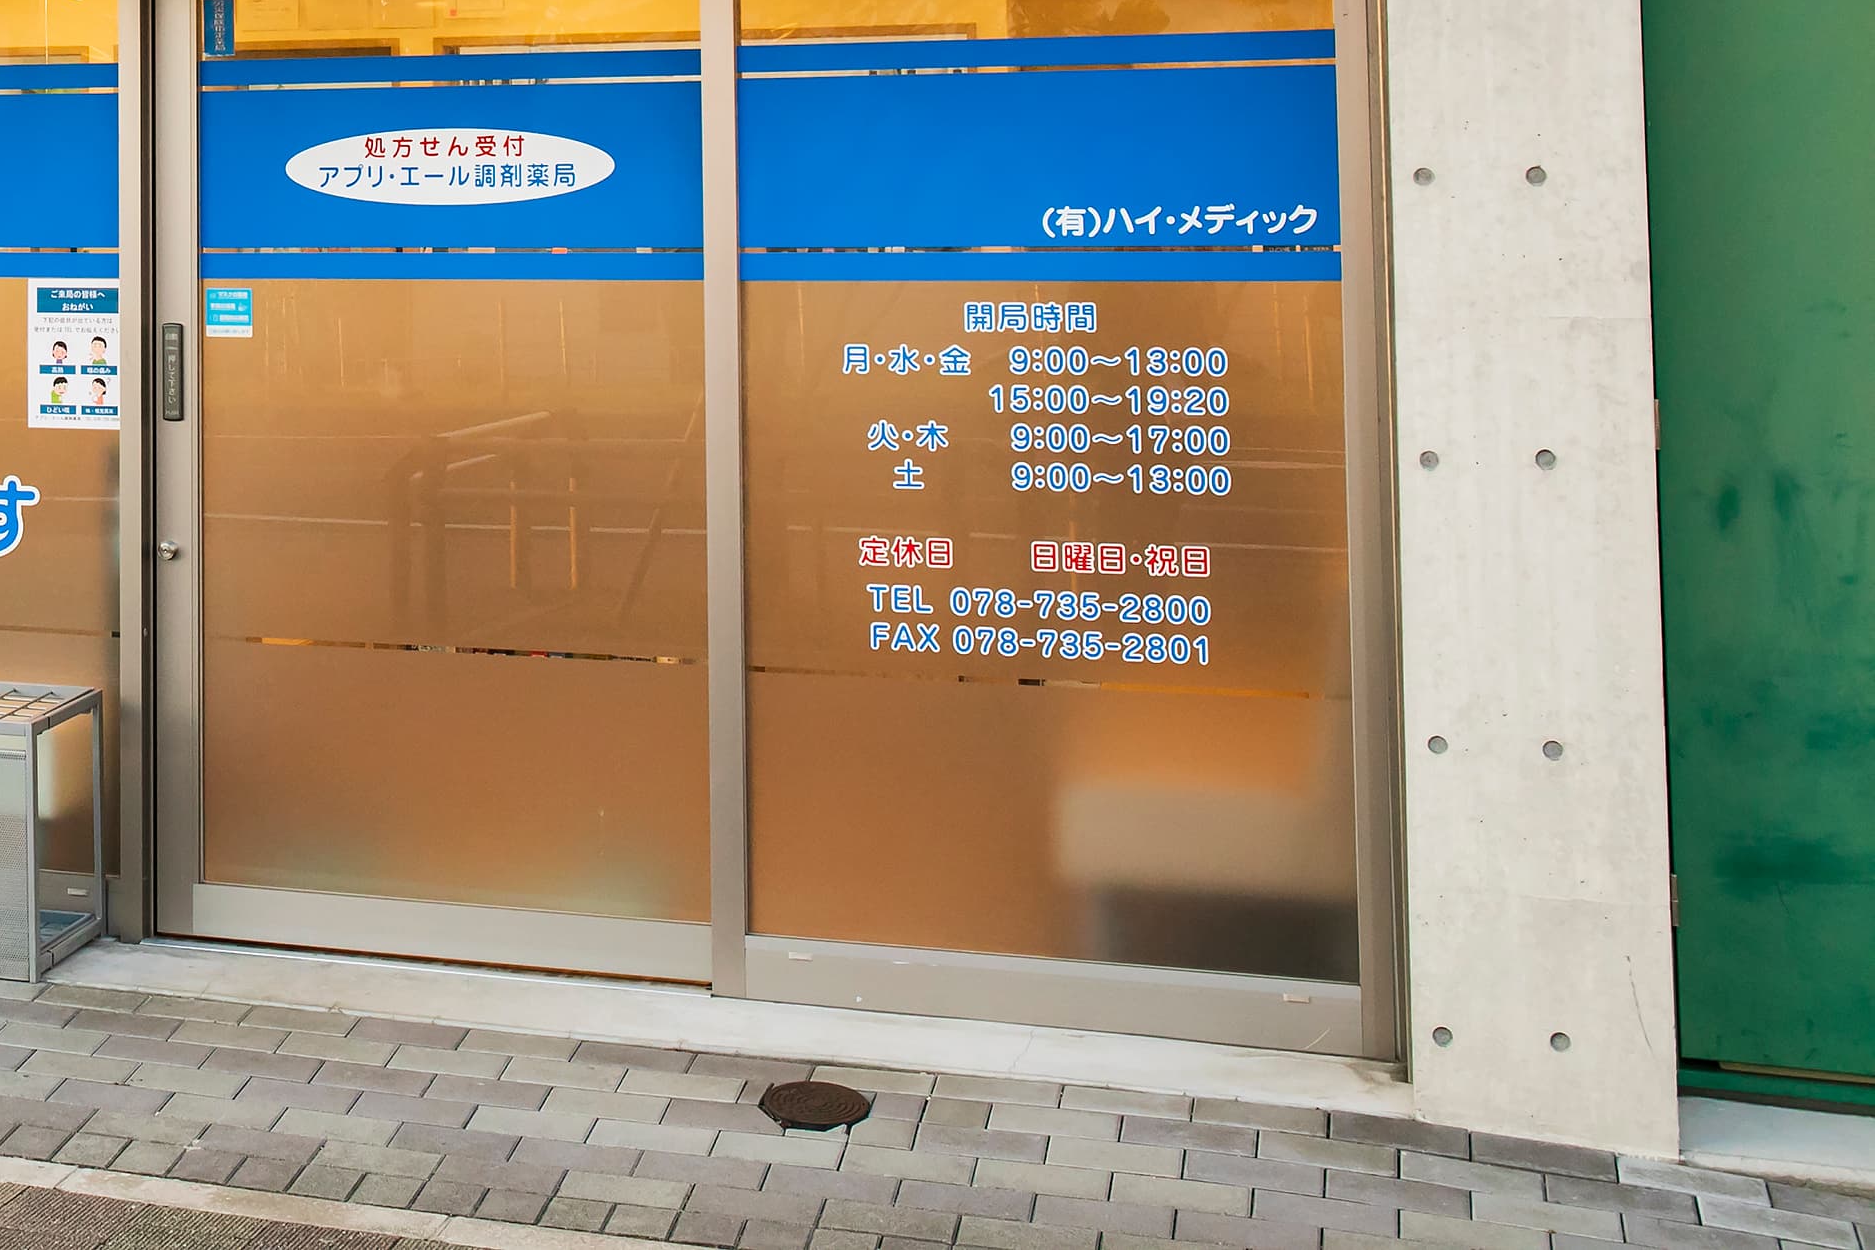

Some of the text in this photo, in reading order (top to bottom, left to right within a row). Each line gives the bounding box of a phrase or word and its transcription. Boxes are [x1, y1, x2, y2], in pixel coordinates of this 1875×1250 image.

[364, 135, 525, 159] 処方せん受付
[318, 163, 577, 189] アプリ・エール調剤薬局
[1041, 203, 1318, 238] (有)ハイ・メディック
[61, 303, 94, 311] おねがい
[964, 302, 1097, 333] 開局時間
[868, 420, 949, 452] 火・木
[893, 459, 926, 491] 土
[859, 536, 1212, 577] 定休日 日曜日・祝日
[867, 584, 1212, 626] TEL 078-735-2800
[870, 622, 1211, 666] FAX 078-735-2801
